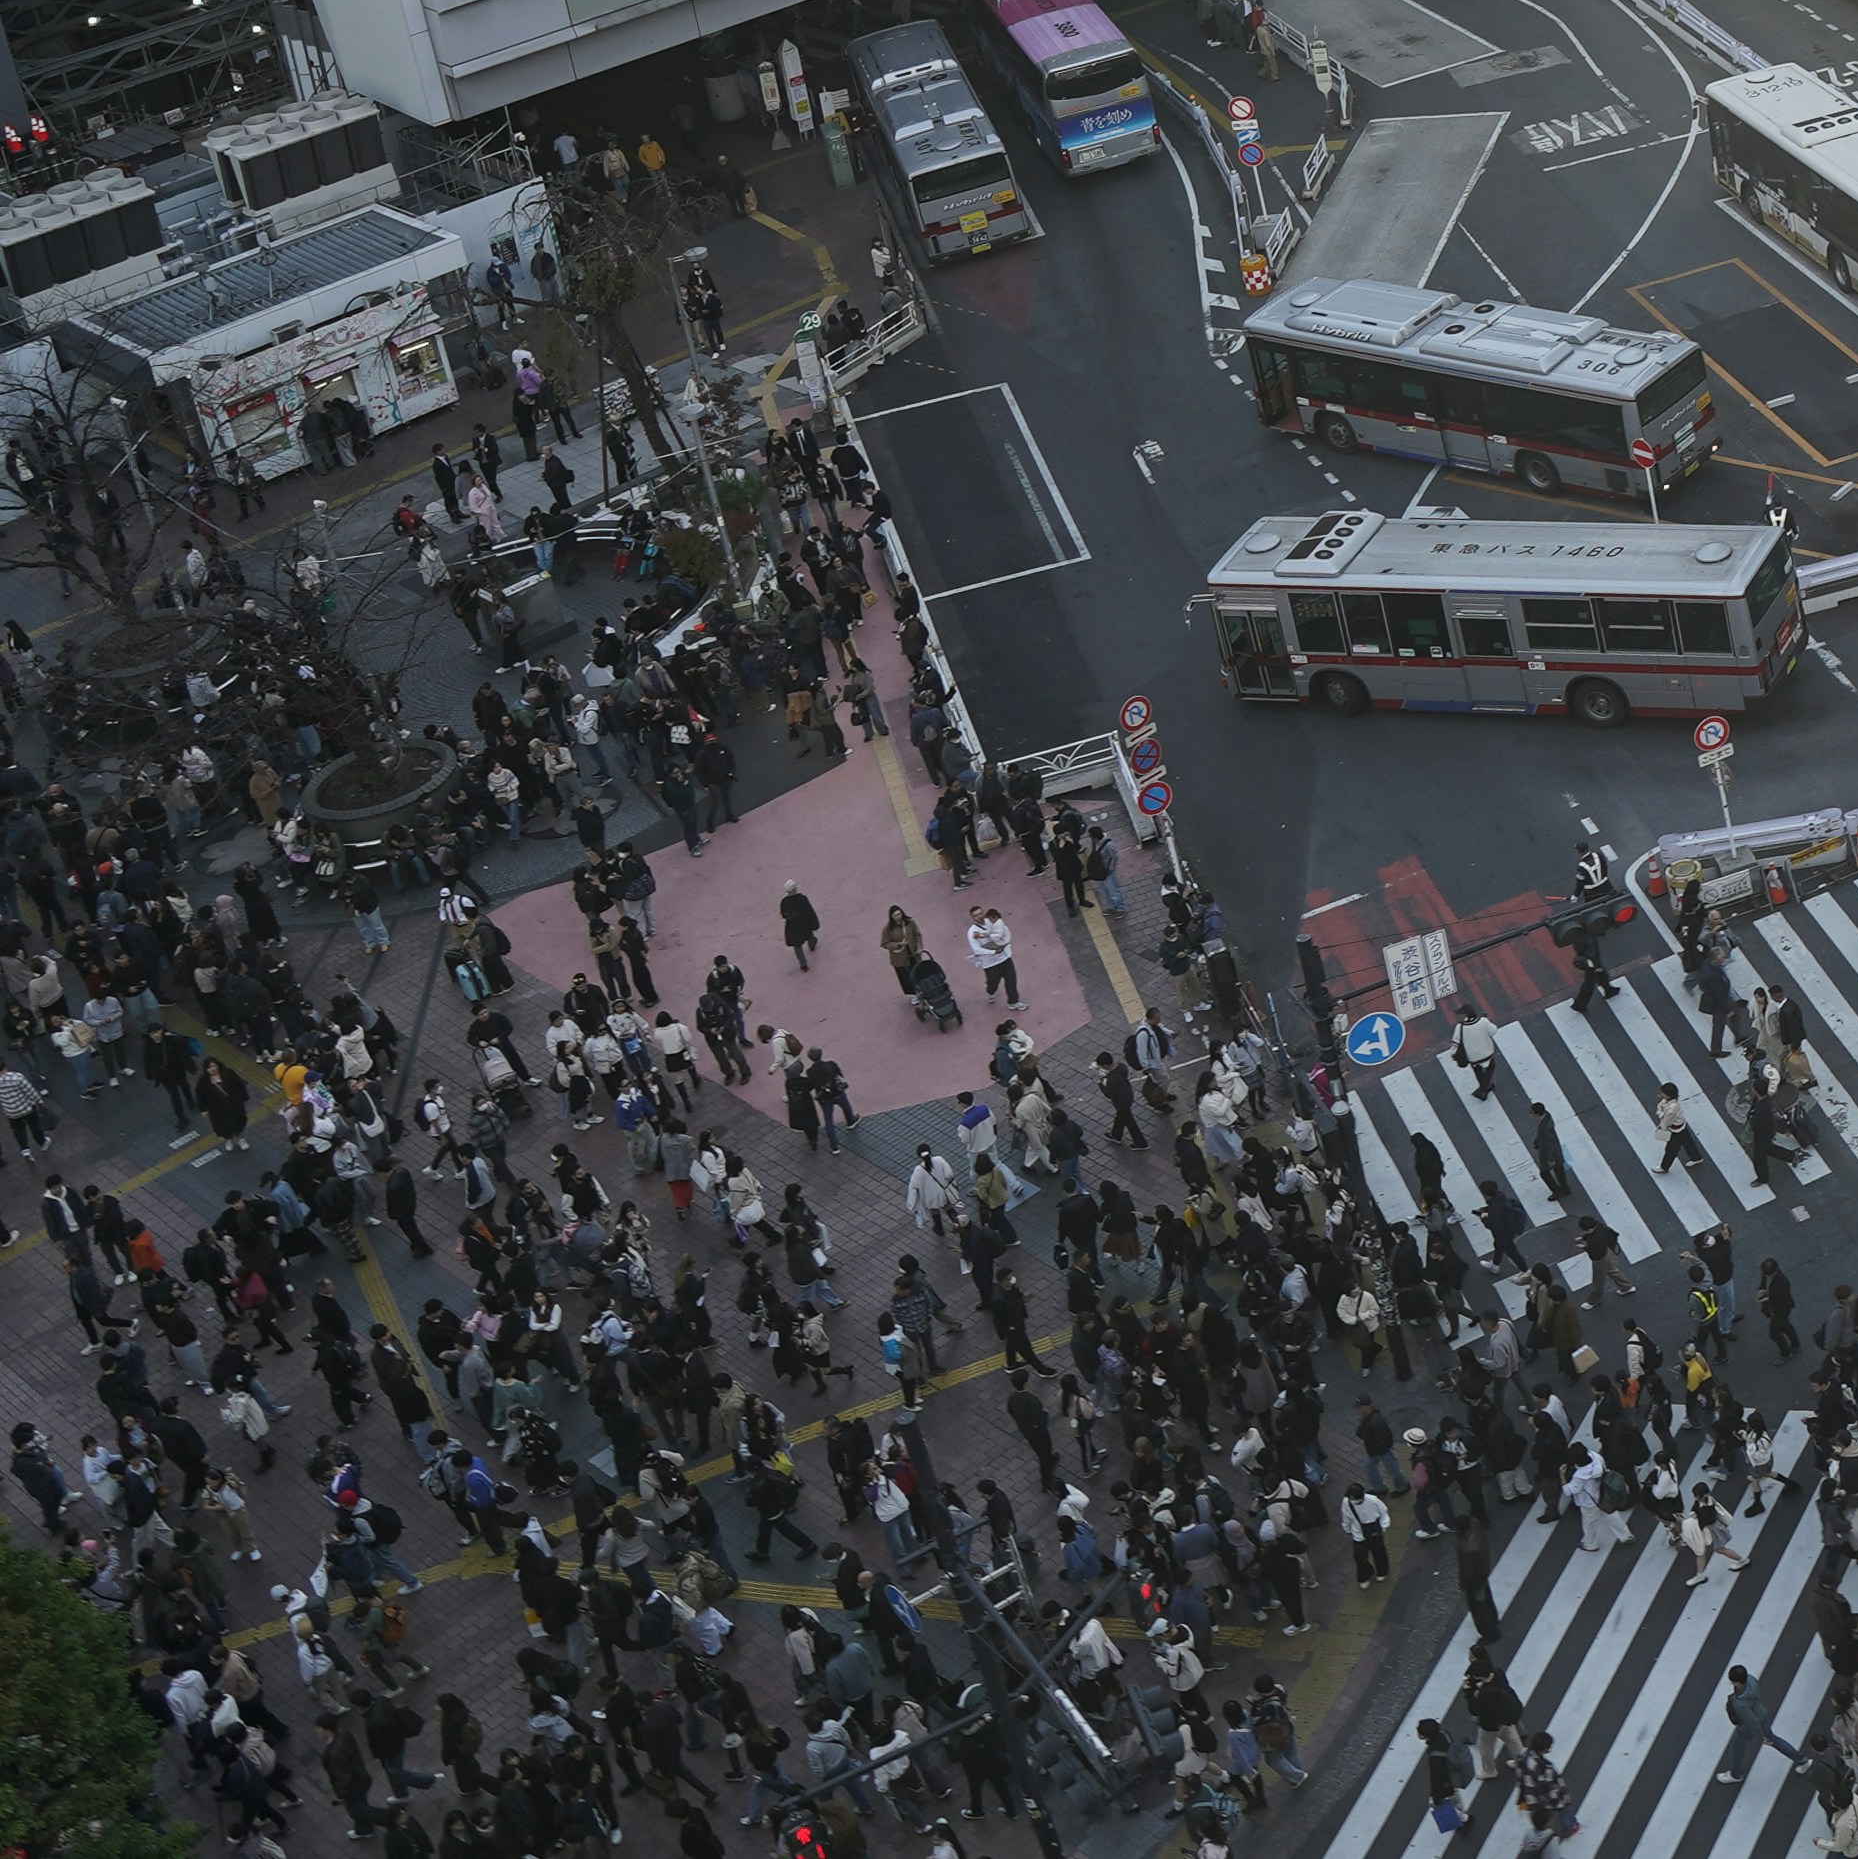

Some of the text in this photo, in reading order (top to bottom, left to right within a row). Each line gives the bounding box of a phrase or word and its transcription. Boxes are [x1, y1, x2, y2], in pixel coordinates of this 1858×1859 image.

[803, 311, 822, 331] 29
[1310, 323, 1373, 343] Hybrid
[1577, 359, 1624, 377] 306
[1430, 542, 1626, 559] 東急バス 1460
[1400, 944, 1429, 1011] 渋谷駅前
